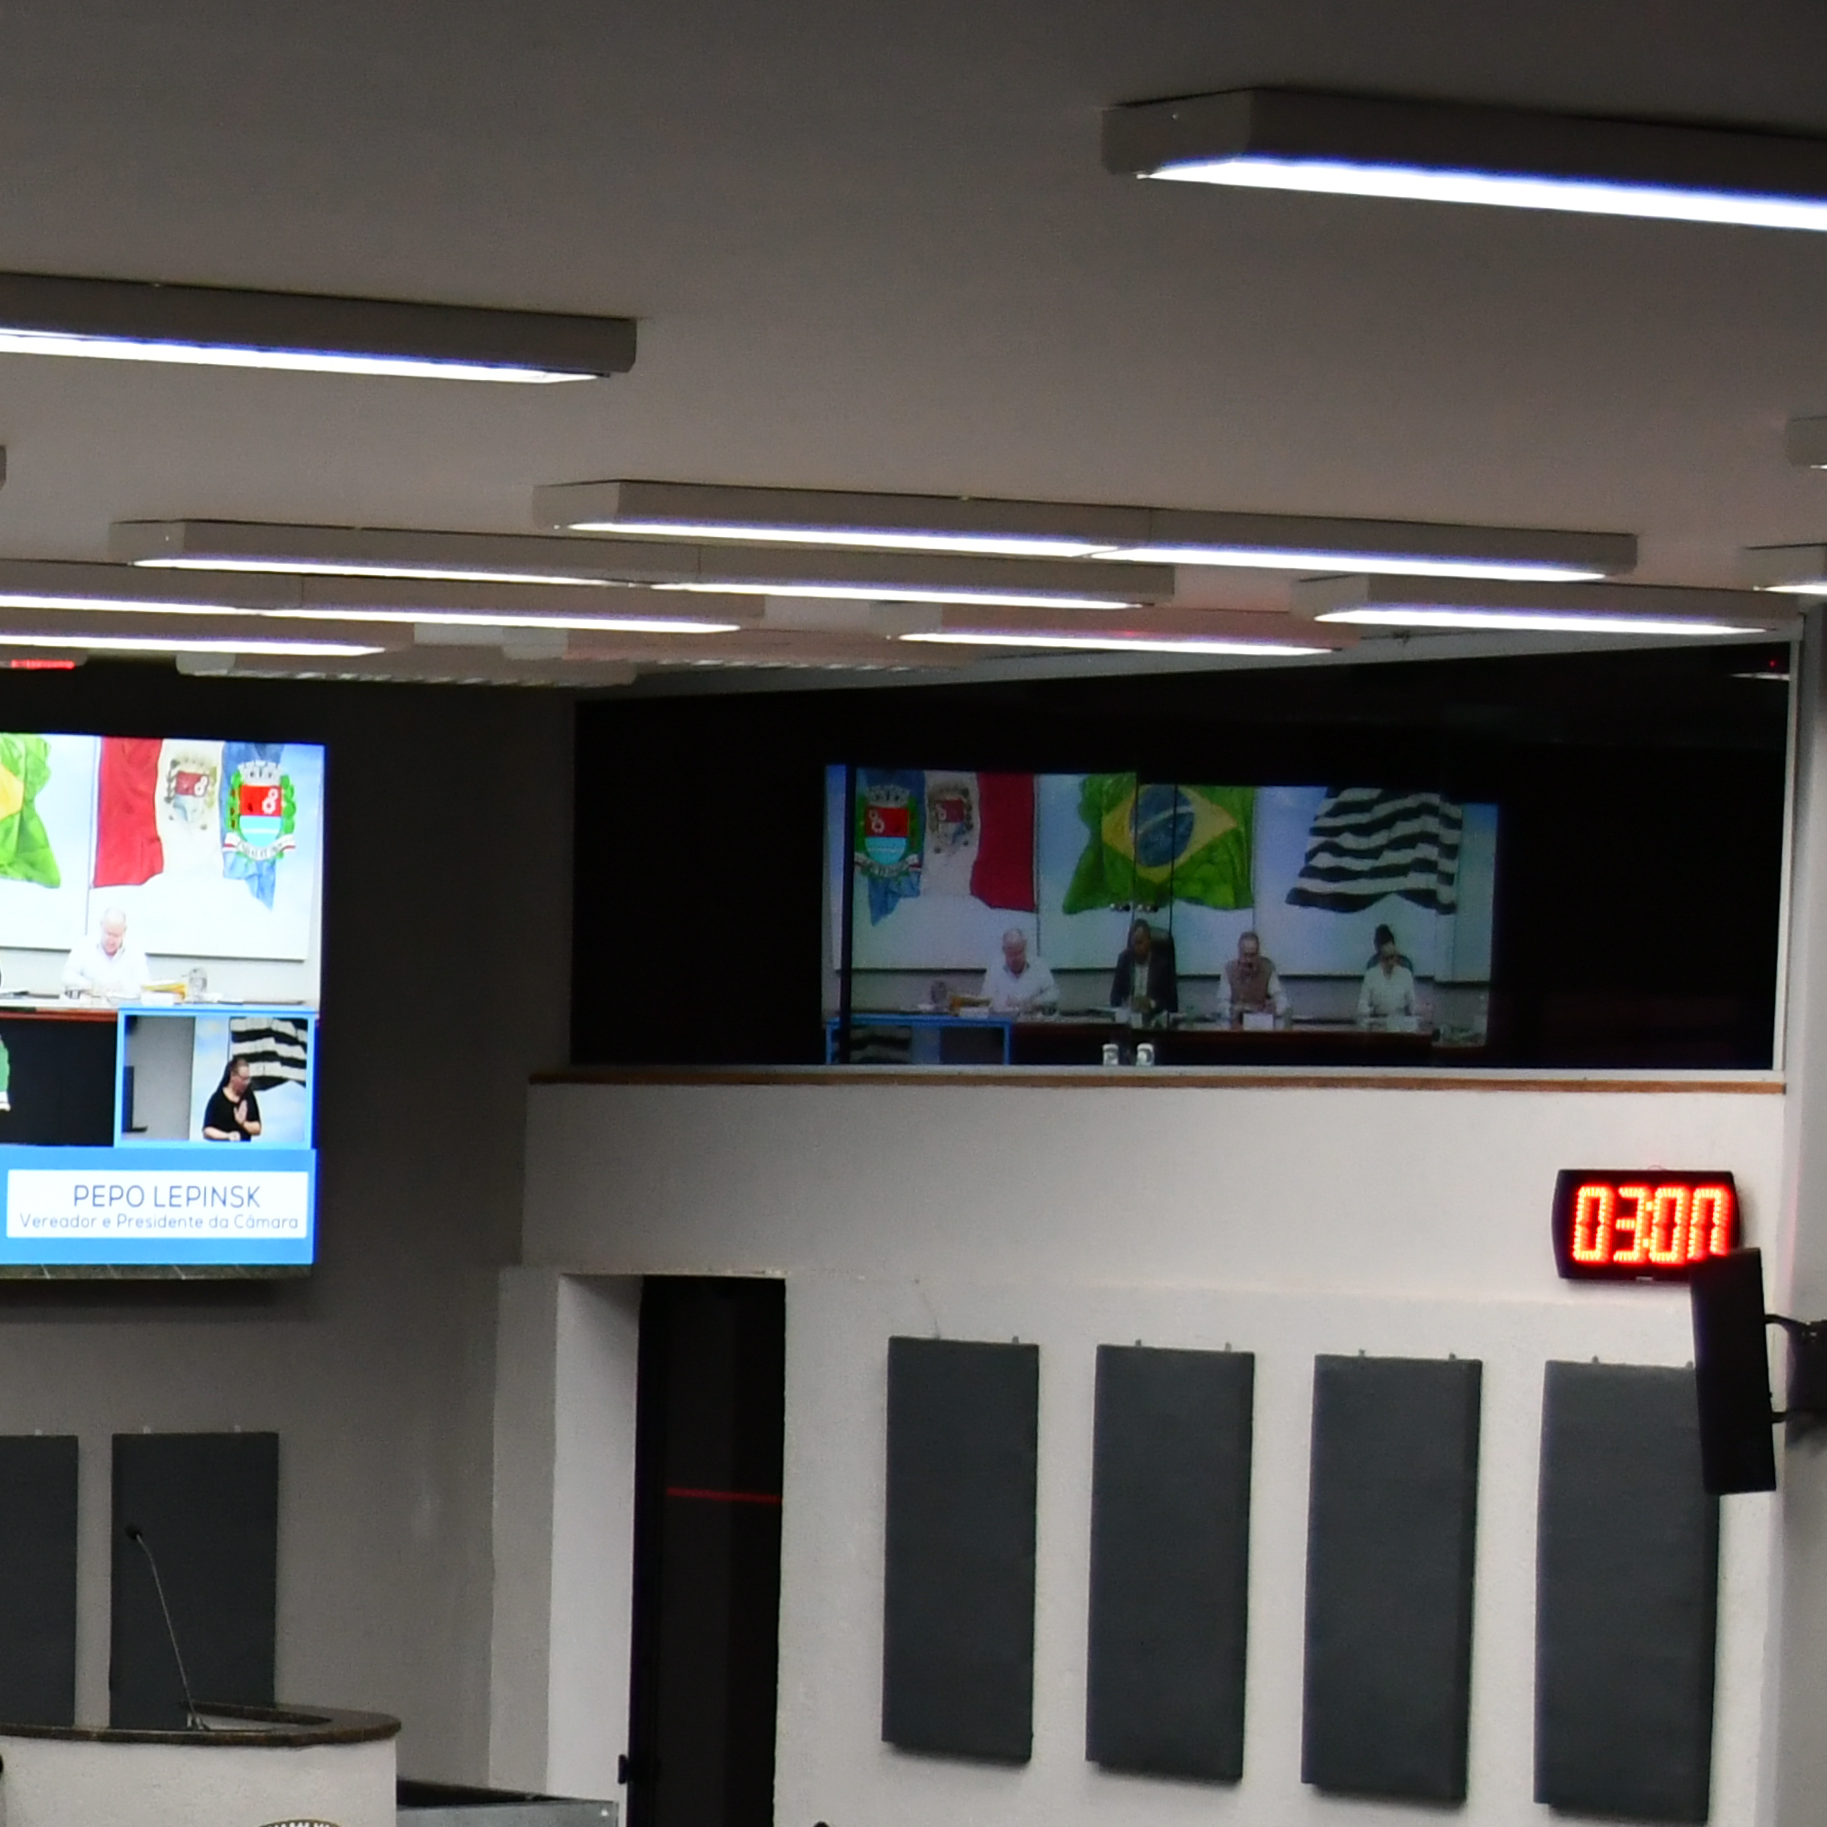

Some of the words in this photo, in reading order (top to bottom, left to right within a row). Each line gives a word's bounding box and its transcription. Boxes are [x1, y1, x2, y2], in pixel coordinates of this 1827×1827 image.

[74, 1184, 145, 1208] PEPO
[154, 1185, 260, 1208] LEPINSK
[20, 1213, 97, 1229] Vereador
[102, 1217, 111, 1229] e
[117, 1213, 203, 1229] Presidente
[208, 1214, 229, 1229] da
[234, 1213, 298, 1229] Câmara
[1571, 1185, 1728, 1263] 03:00
